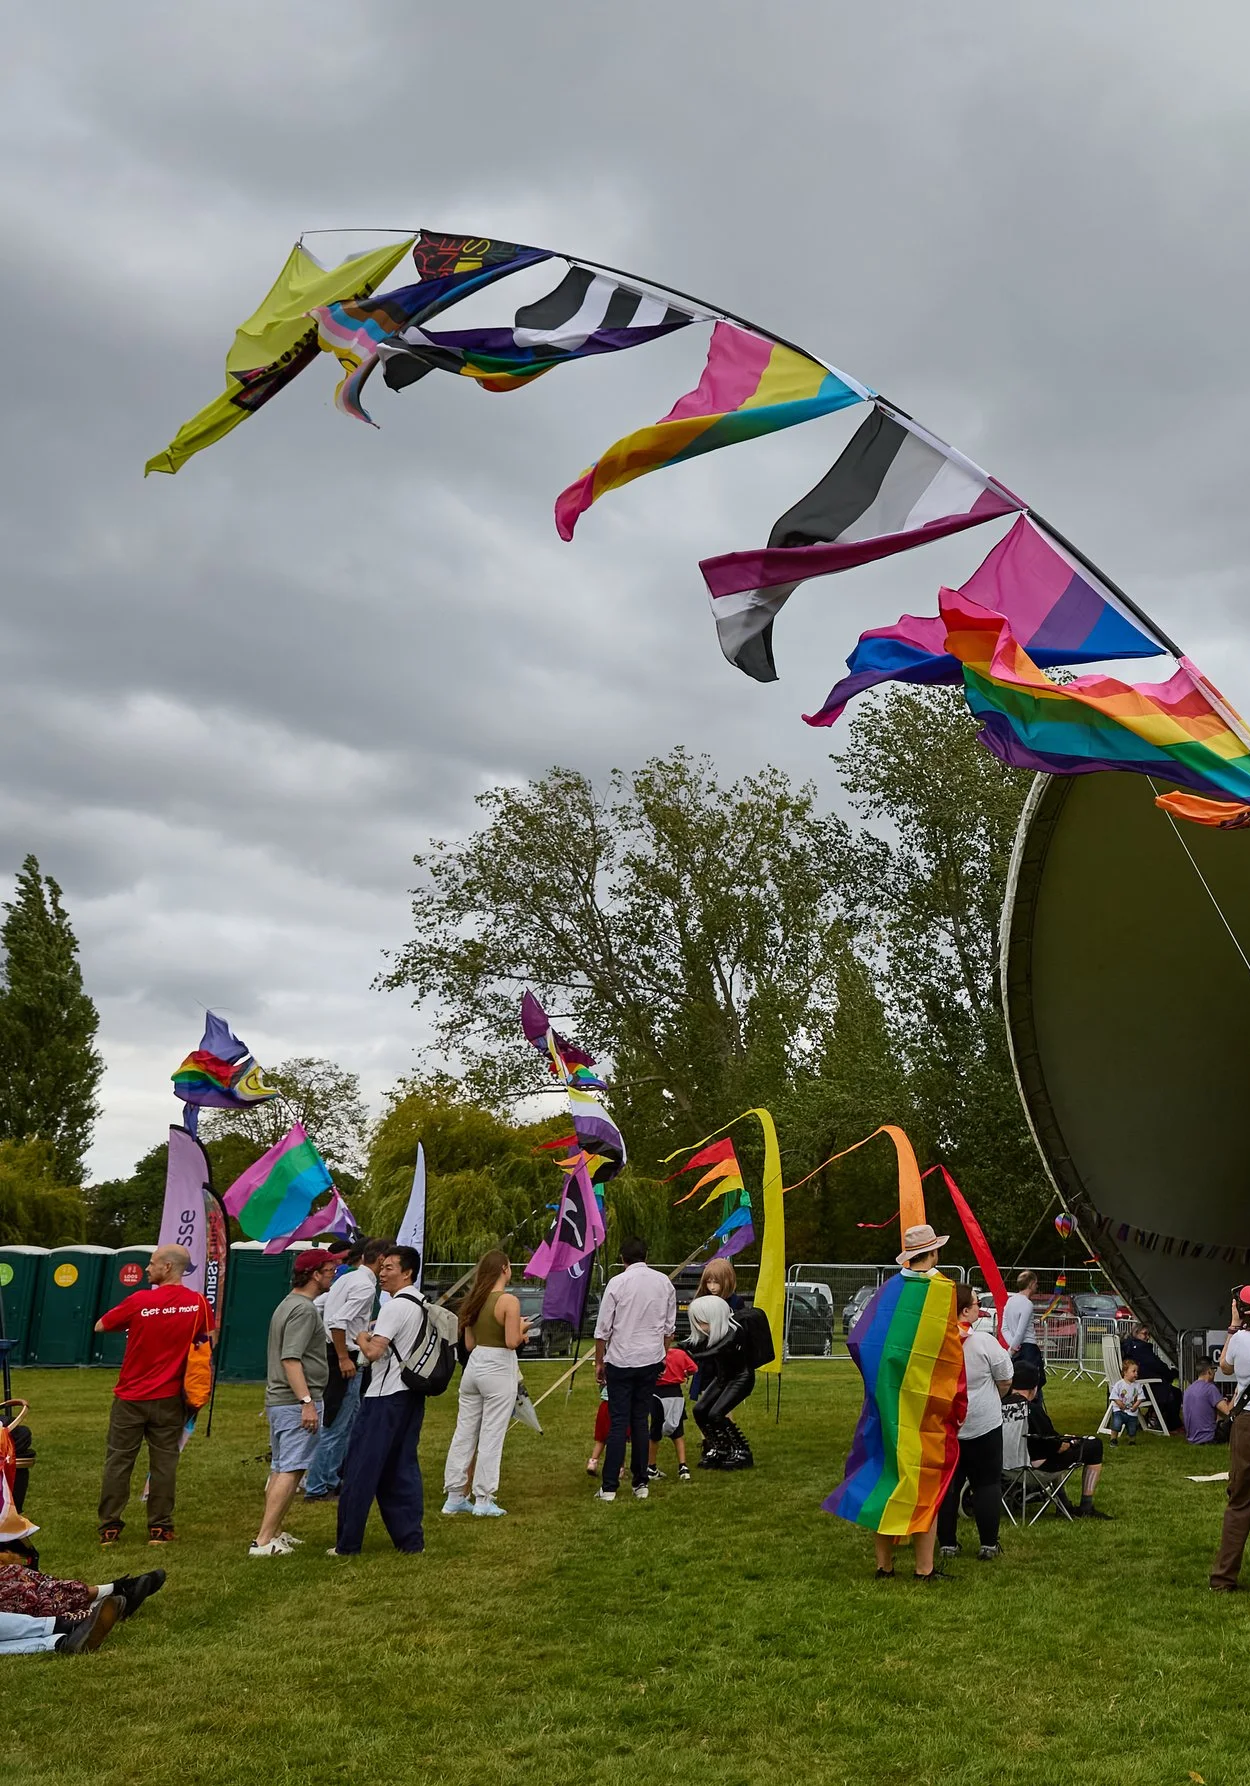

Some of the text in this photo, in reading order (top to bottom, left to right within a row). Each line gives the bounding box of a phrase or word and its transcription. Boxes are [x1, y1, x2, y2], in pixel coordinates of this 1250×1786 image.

[141, 1304, 199, 1317] Get out more
